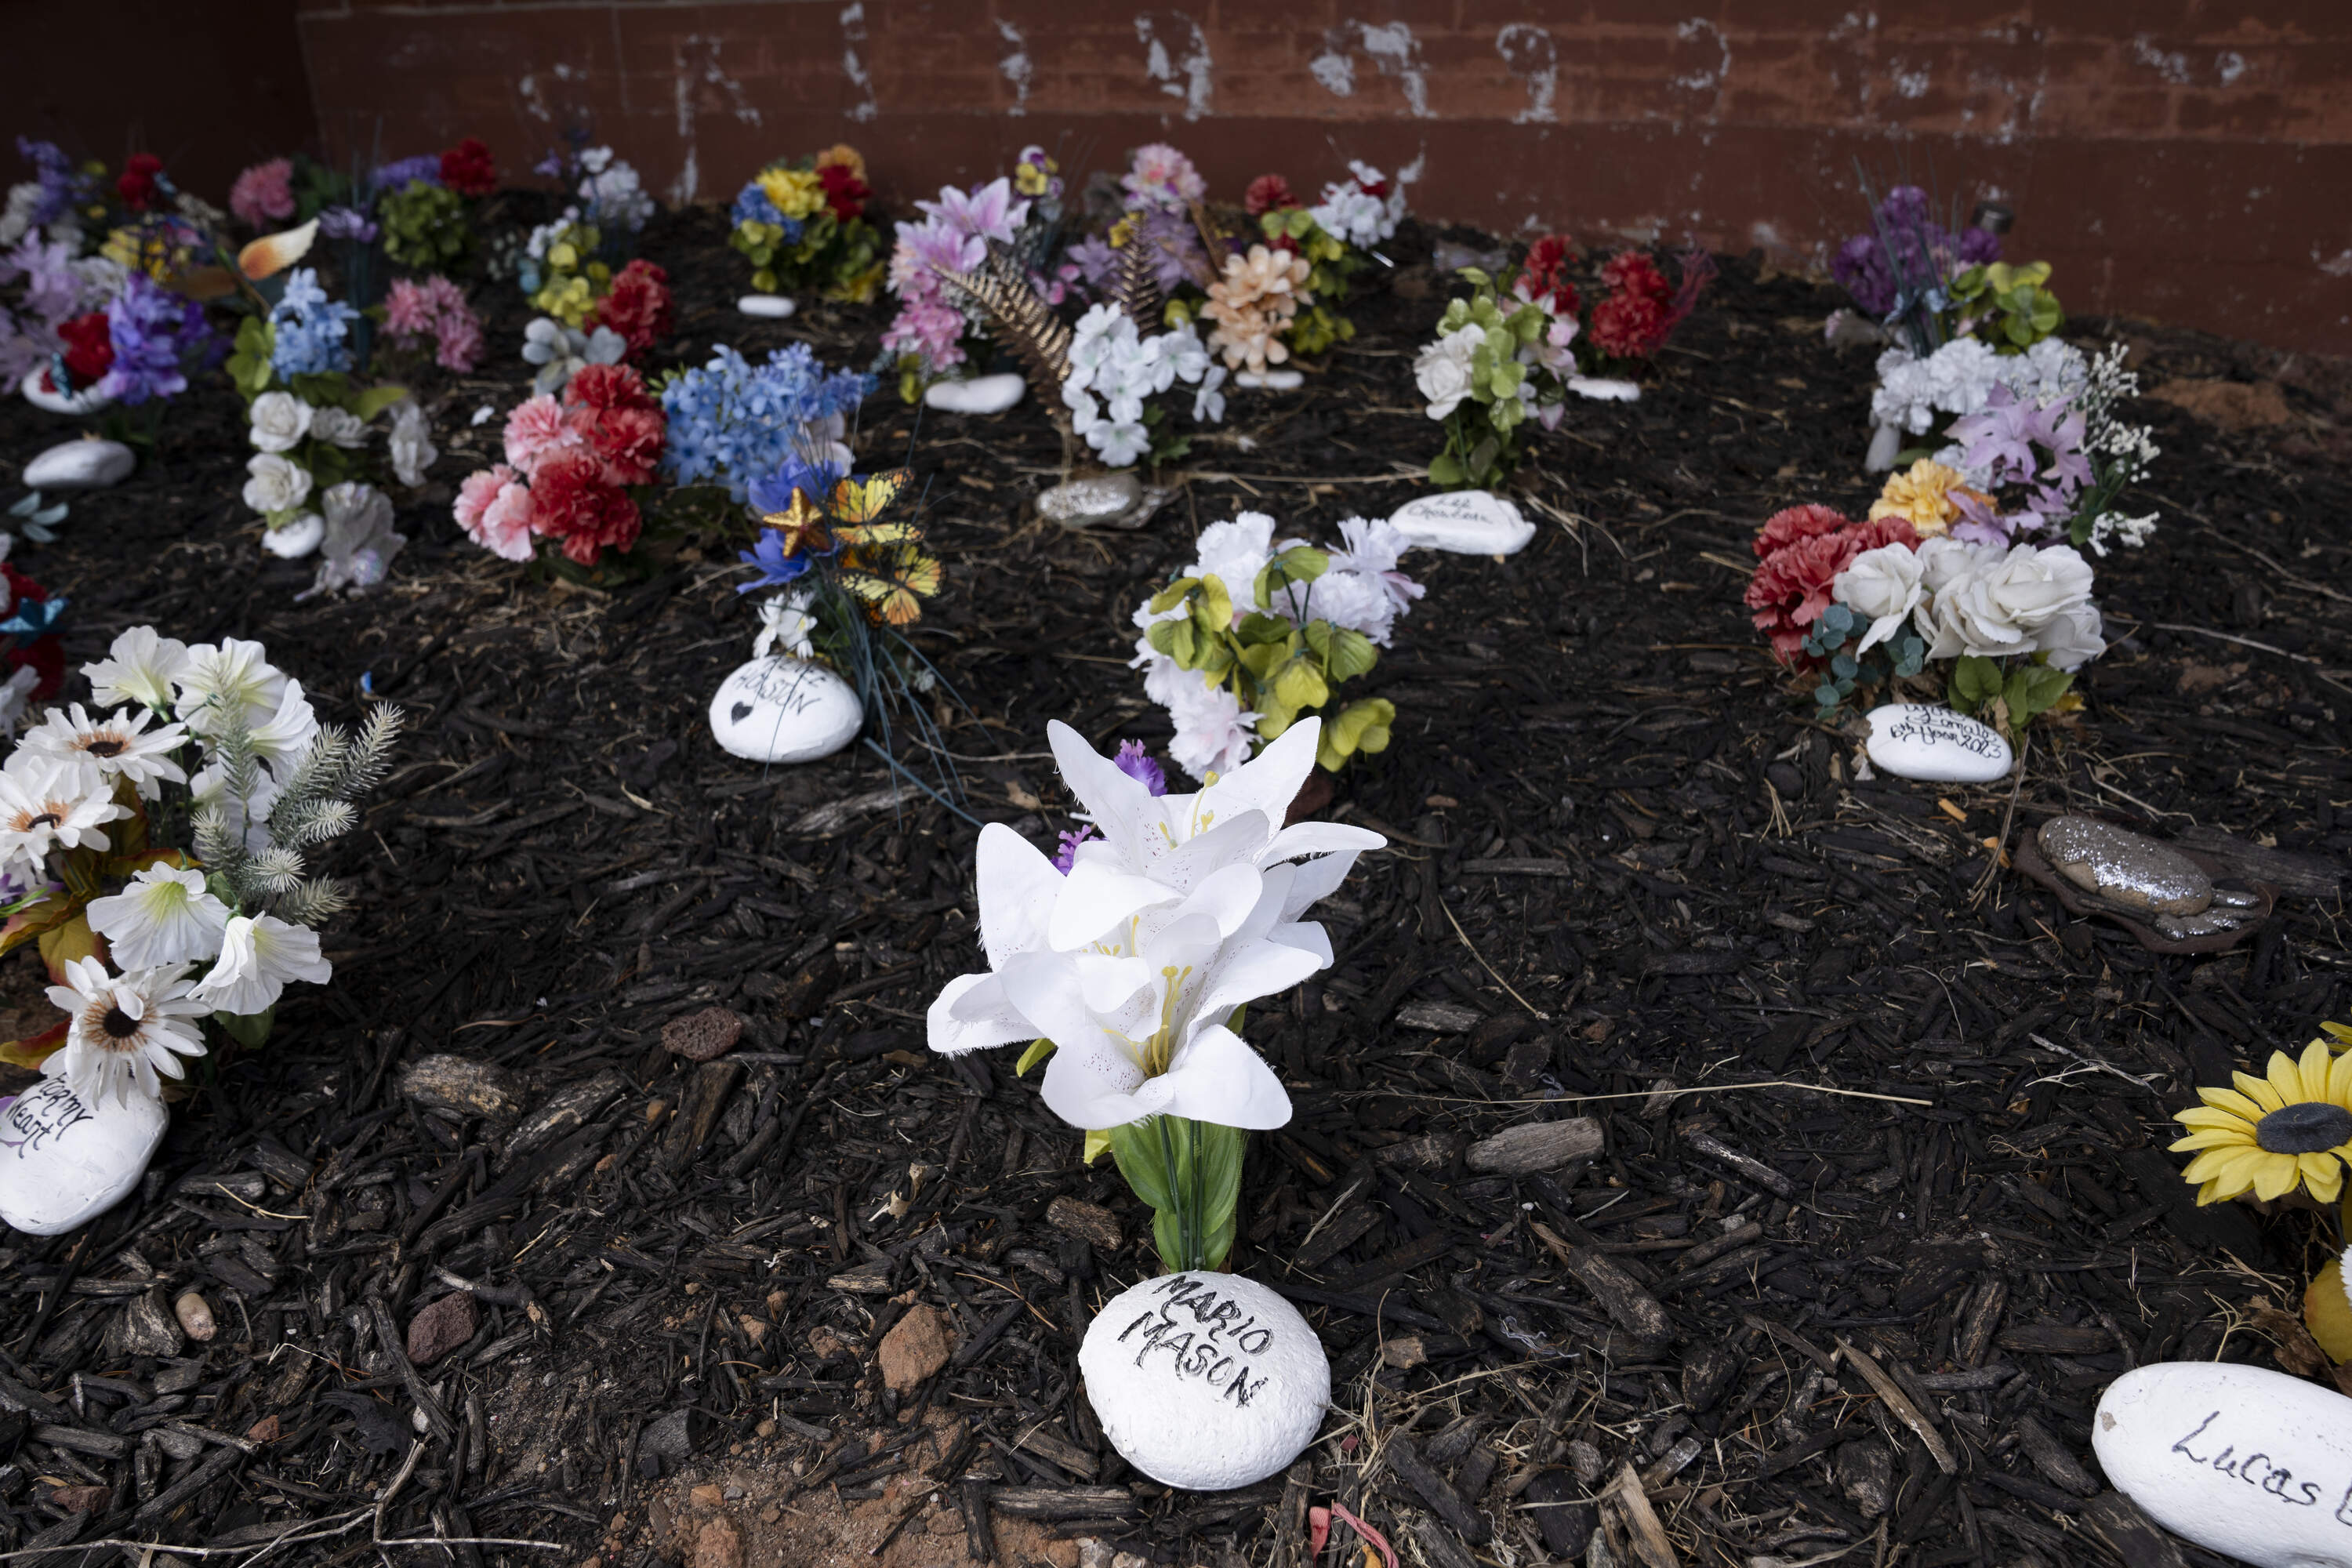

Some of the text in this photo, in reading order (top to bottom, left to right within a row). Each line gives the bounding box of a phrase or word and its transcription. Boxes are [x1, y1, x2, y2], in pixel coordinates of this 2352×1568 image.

[1116, 1310, 1269, 1409] MASON
[1152, 1275, 1274, 1356] MARIO
[2172, 1410, 2321, 1506] Lucas
